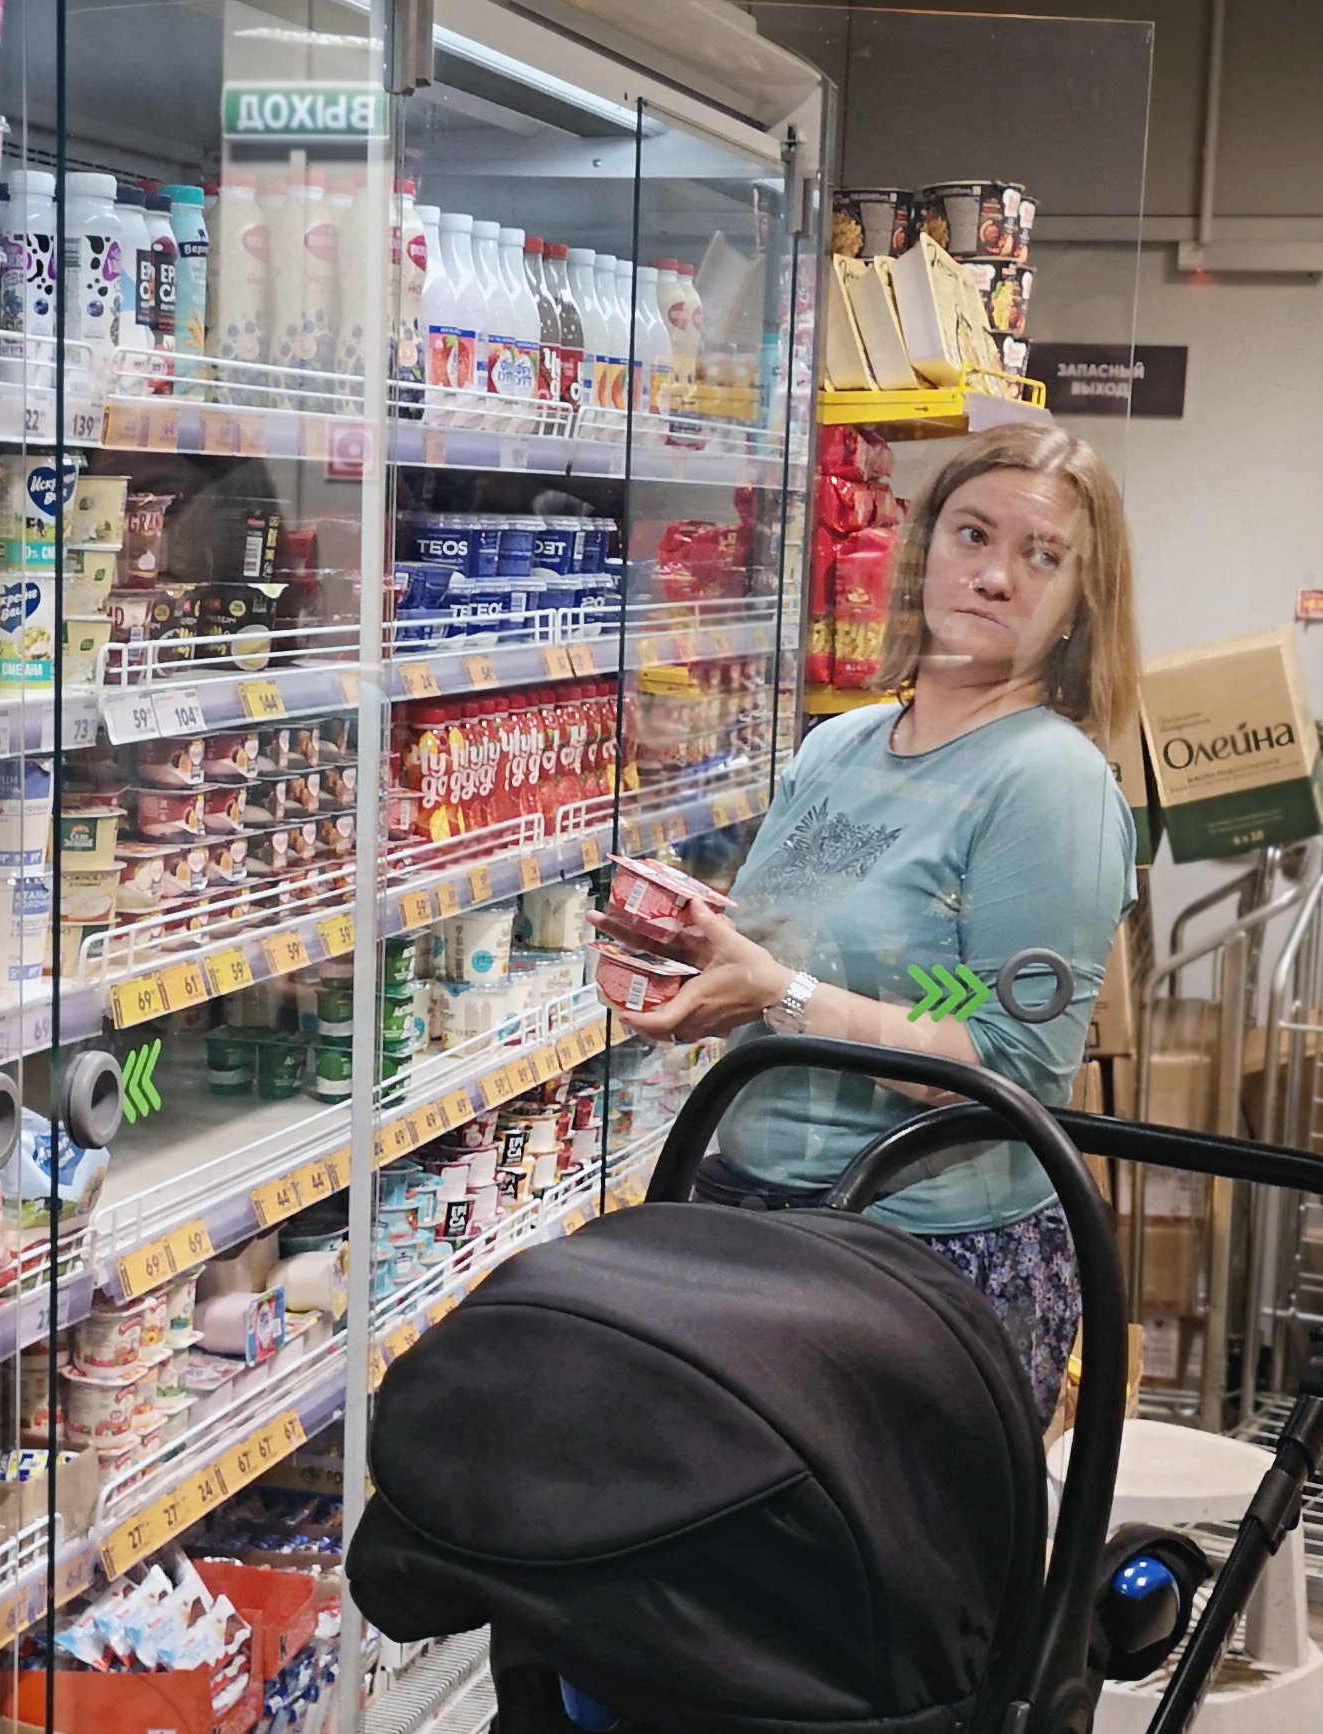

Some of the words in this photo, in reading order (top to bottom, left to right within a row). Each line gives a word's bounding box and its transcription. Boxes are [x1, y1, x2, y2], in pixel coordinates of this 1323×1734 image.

[1058, 361, 1145, 380] ЗАПАСНЫЙ
[1071, 381, 1129, 399] ВЫХОД
[416, 539, 468, 556] TEOS
[132, 711, 148, 728] 59
[174, 707, 197, 727] 104
[1163, 722, 1295, 770] Олейна
[339, 928, 351, 945] 59
[288, 943, 300, 960] 59
[231, 961, 245, 981] 59
[184, 976, 198, 994] 61
[137, 990, 152, 1011] 69
[311, 1174, 324, 1190] 44
[276, 1188, 290, 1207] 44
[188, 1234, 202, 1253] 69
[146, 1254, 160, 1276] 69
[284, 1420, 297, 1440] 67
[258, 1438, 272, 1459] 67
[237, 1454, 251, 1474] 67
[198, 1480, 213, 1503] 24
[163, 1505, 178, 1528] 27
[127, 1525, 144, 1550] 27
